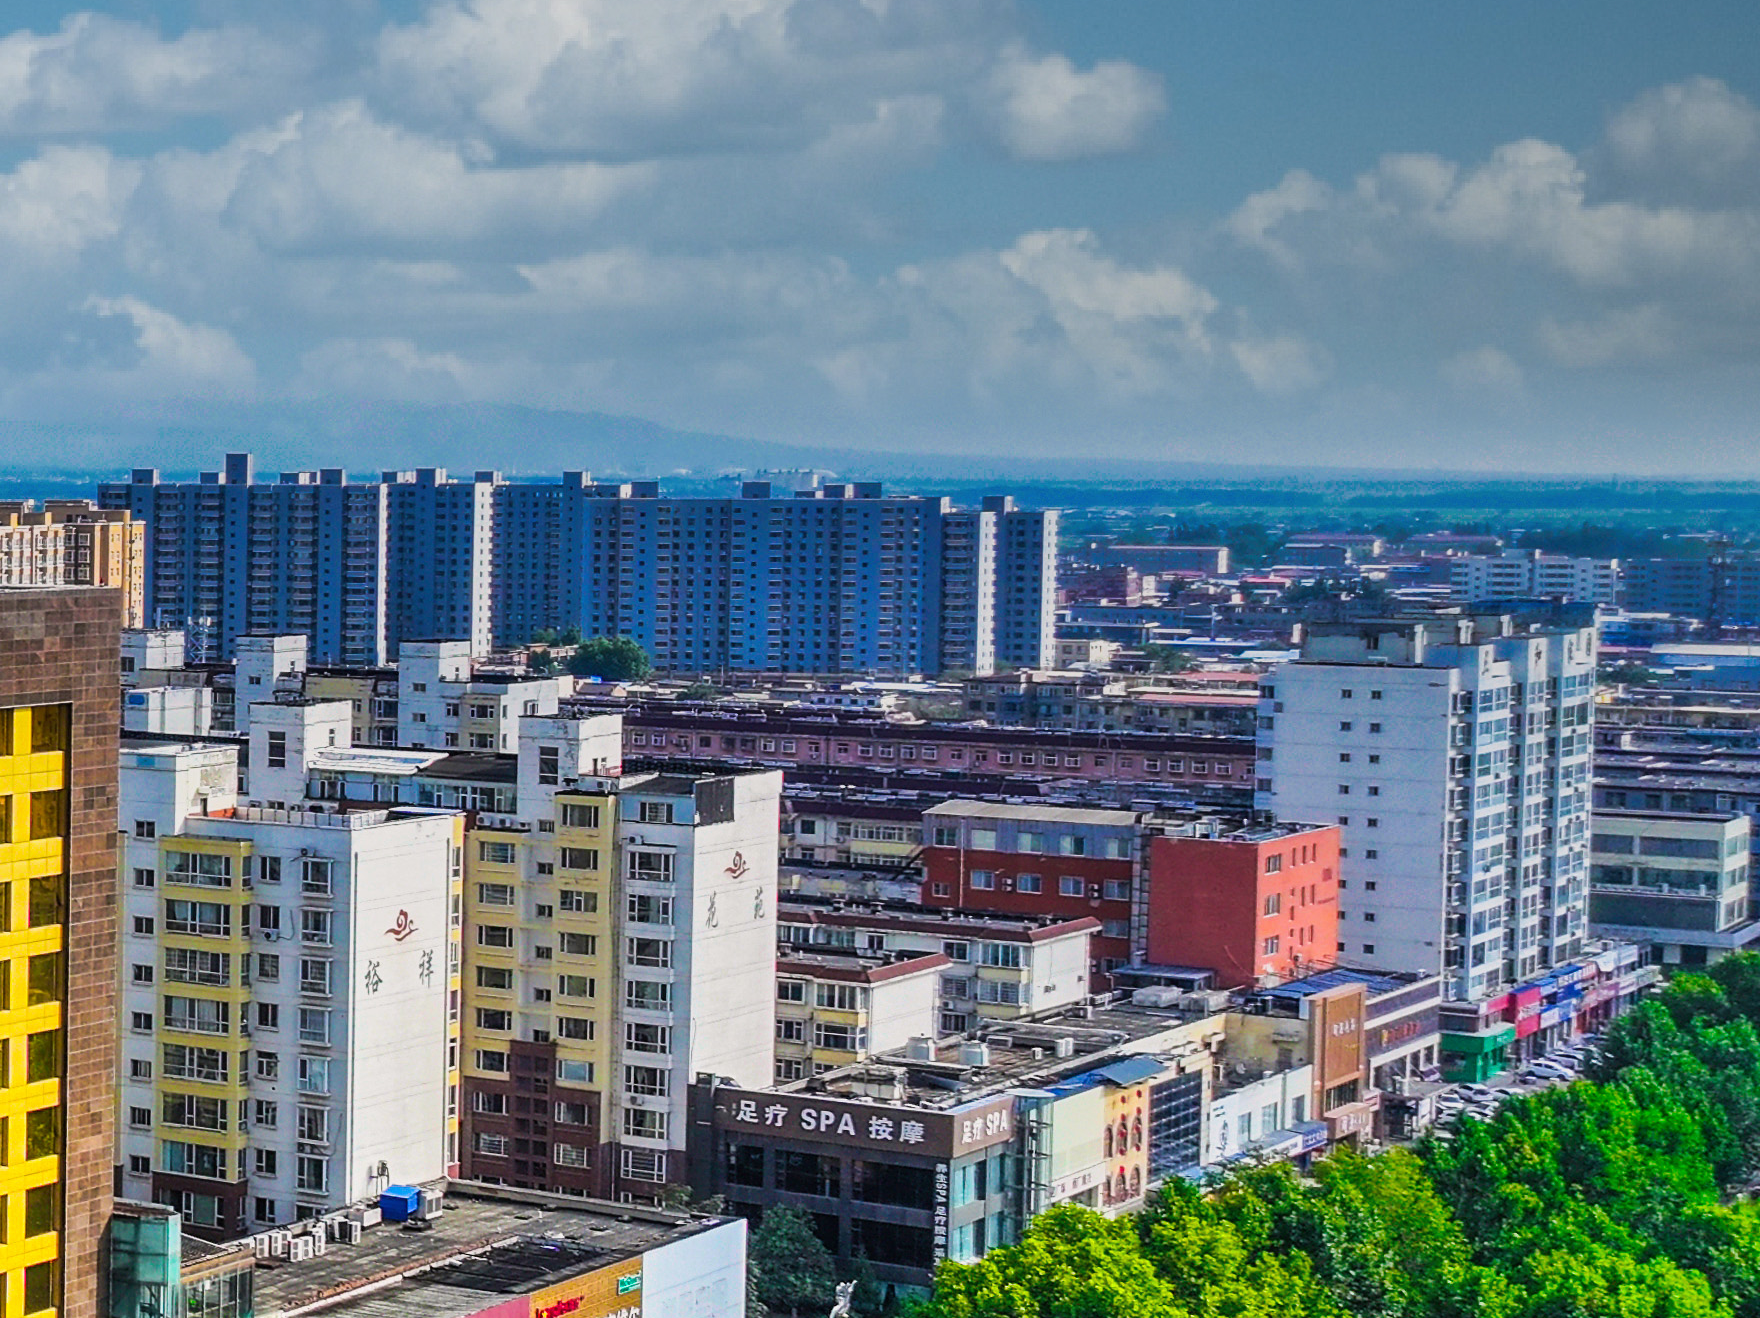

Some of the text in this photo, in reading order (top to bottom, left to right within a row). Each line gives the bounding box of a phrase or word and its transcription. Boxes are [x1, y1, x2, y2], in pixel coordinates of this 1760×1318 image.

[736, 1100, 924, 1144] 足疗 SPA 按摩
[986, 1109, 1008, 1136] SPA
